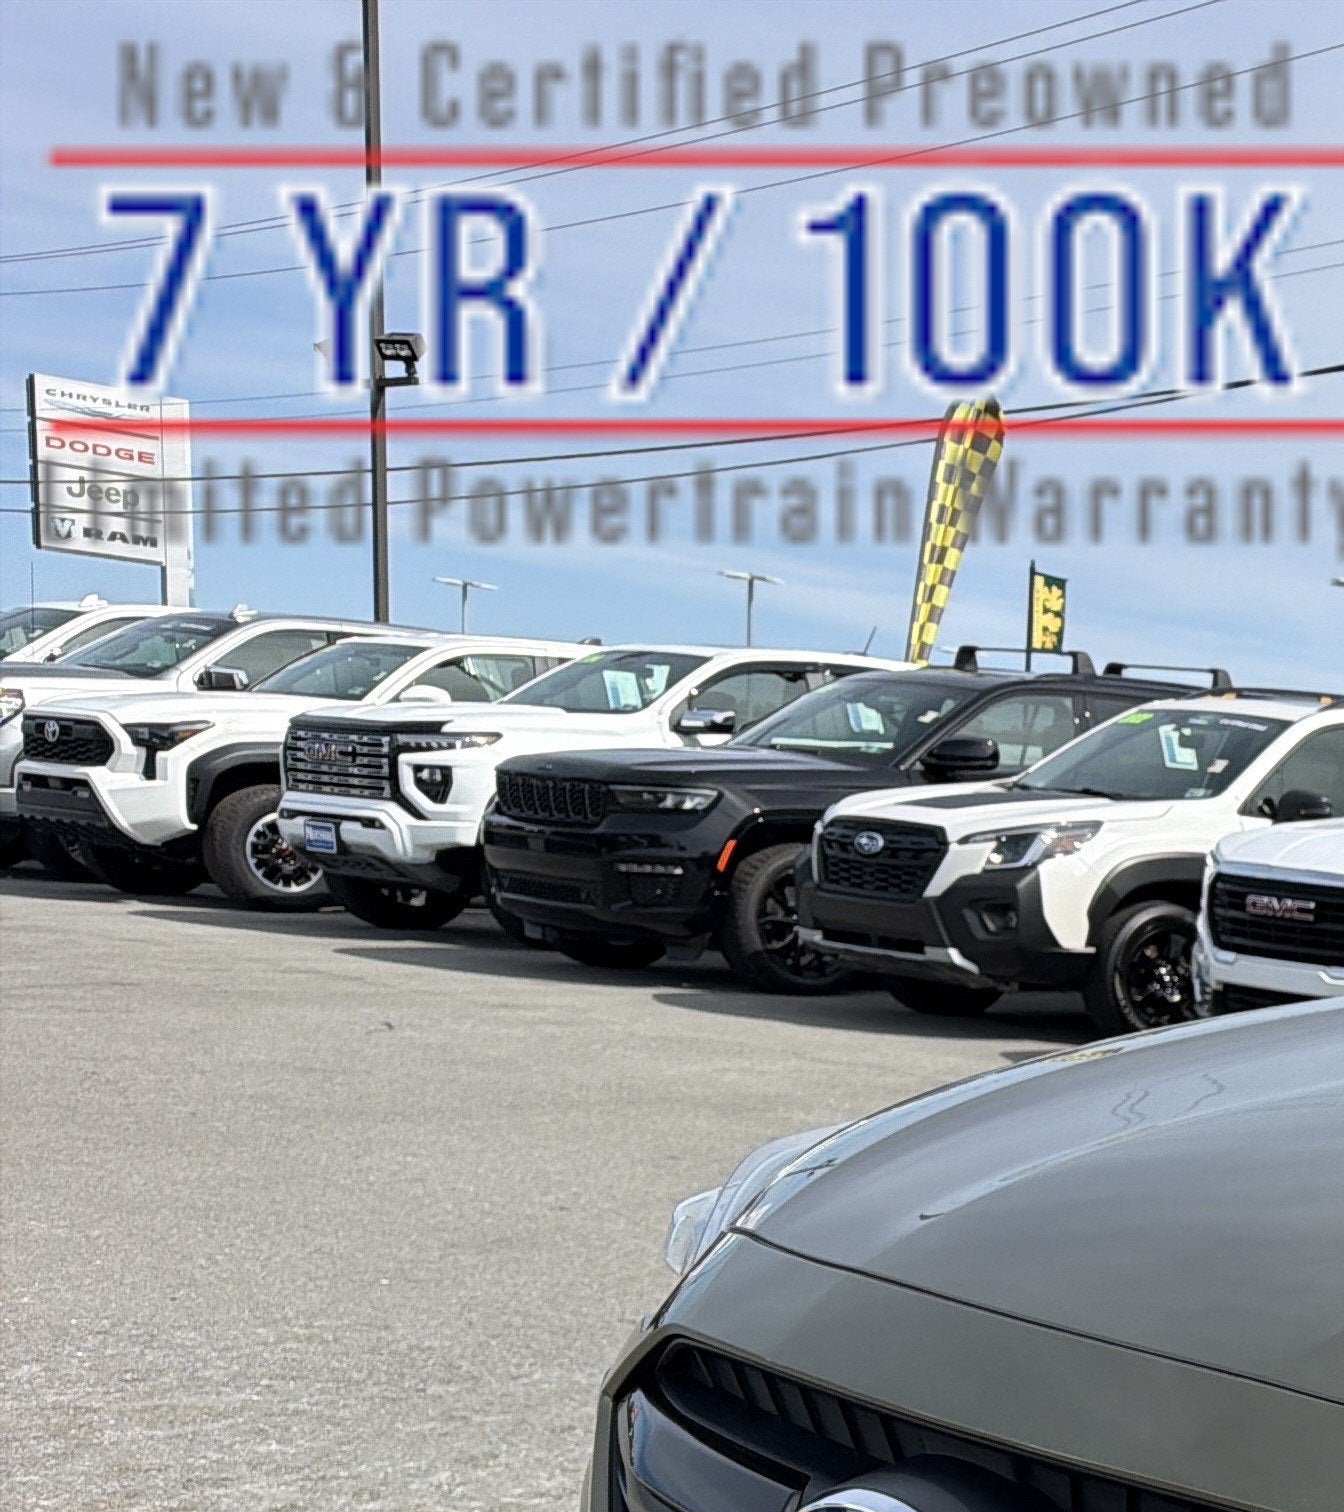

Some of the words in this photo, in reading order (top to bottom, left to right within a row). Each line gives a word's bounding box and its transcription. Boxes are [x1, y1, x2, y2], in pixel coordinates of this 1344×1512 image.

[44, 388, 152, 414] CHRYSLER
[44, 435, 156, 466] DODGE
[66, 475, 141, 510] Jeep
[82, 526, 159, 549] RAM
[1245, 893, 1316, 922] GMC
